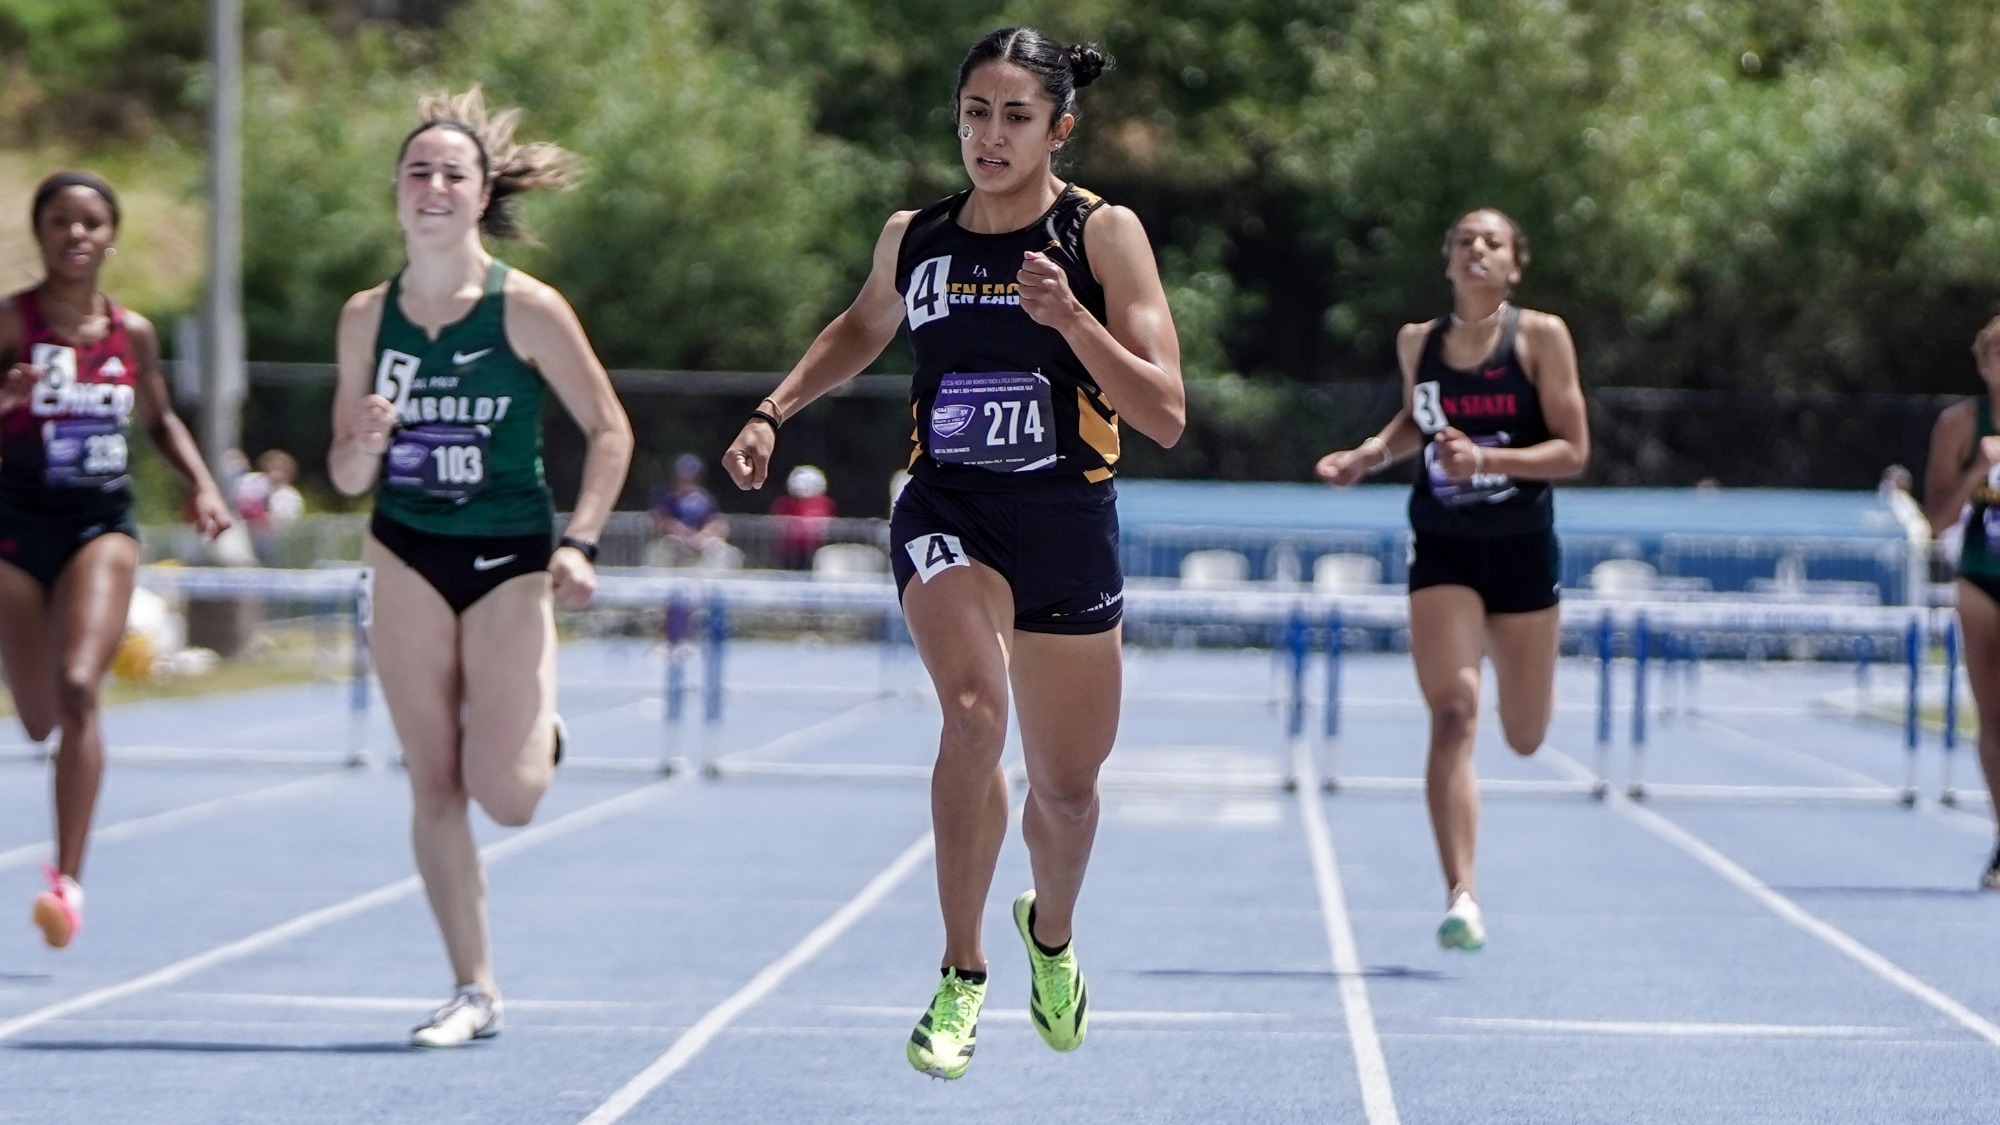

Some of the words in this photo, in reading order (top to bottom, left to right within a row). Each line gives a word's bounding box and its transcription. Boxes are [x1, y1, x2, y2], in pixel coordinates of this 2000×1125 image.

[914, 261, 939, 316] 4
[389, 358, 408, 403] 5
[396, 396, 512, 423] MBOLDT
[984, 400, 1044, 446] 274
[1418, 386, 1434, 426] 3
[430, 446, 483, 484] 103
[926, 535, 959, 569] 4
